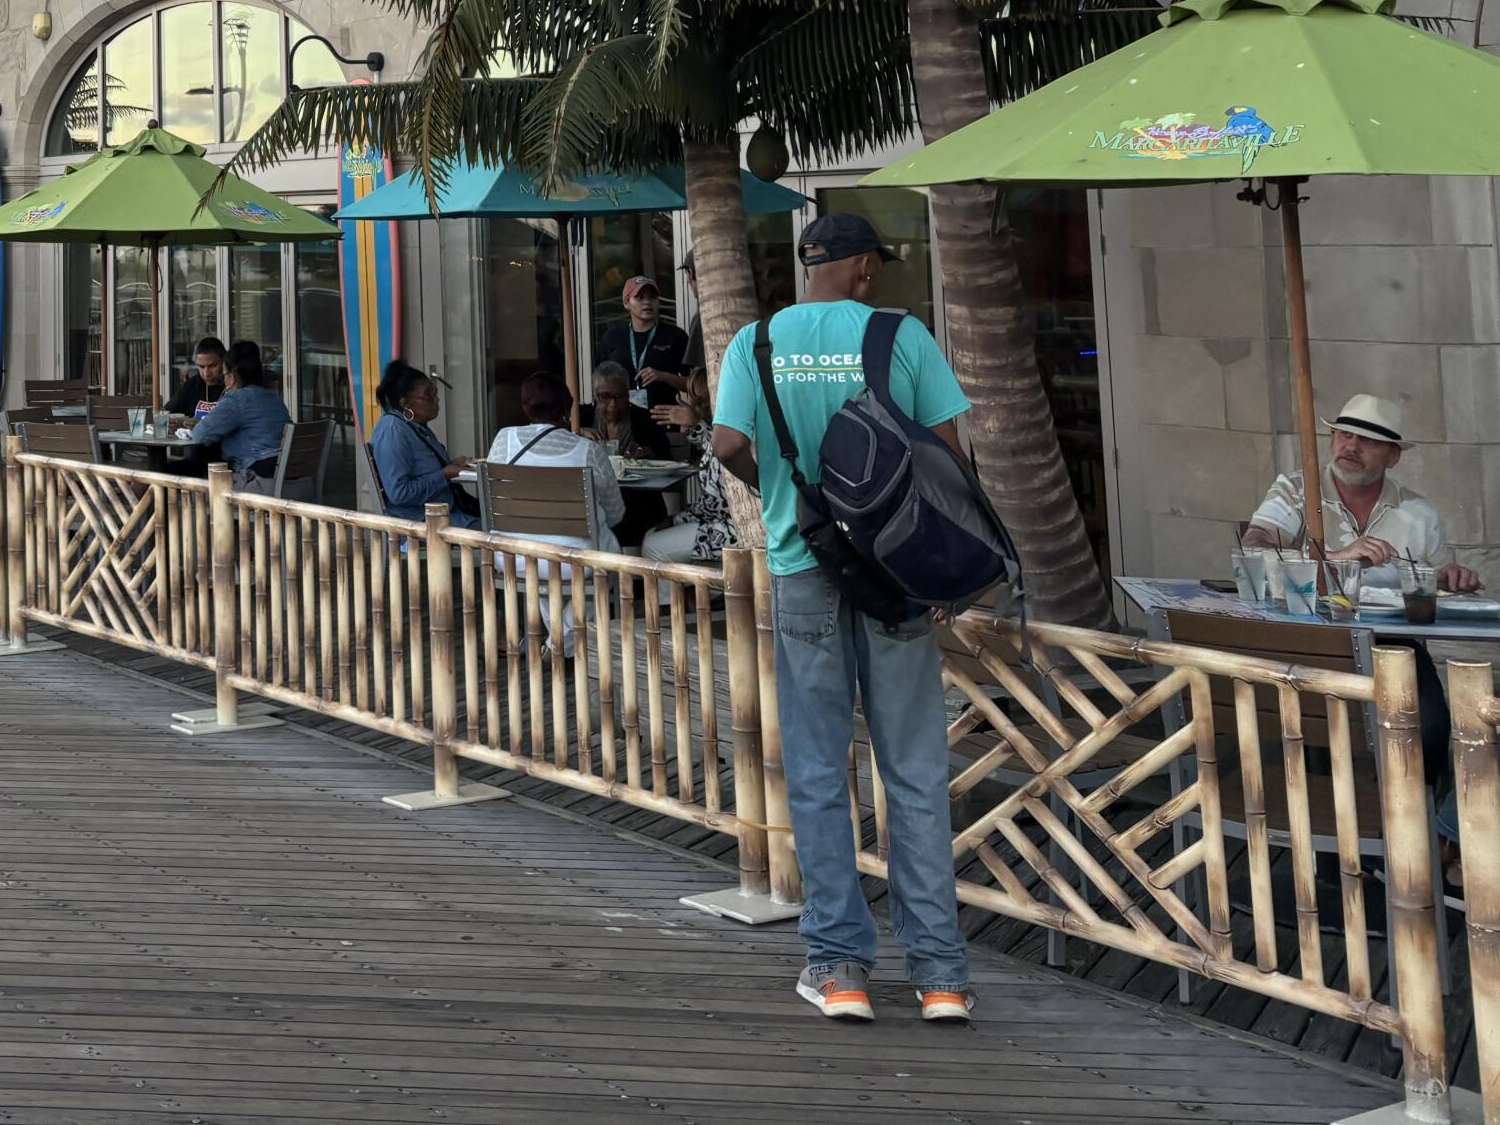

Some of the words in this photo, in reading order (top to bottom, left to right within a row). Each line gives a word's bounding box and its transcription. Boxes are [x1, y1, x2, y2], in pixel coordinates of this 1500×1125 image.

[790, 354, 814, 366] TO
[819, 353, 862, 366] OCEA
[787, 372, 817, 383] FOR
[820, 372, 846, 383] THE
